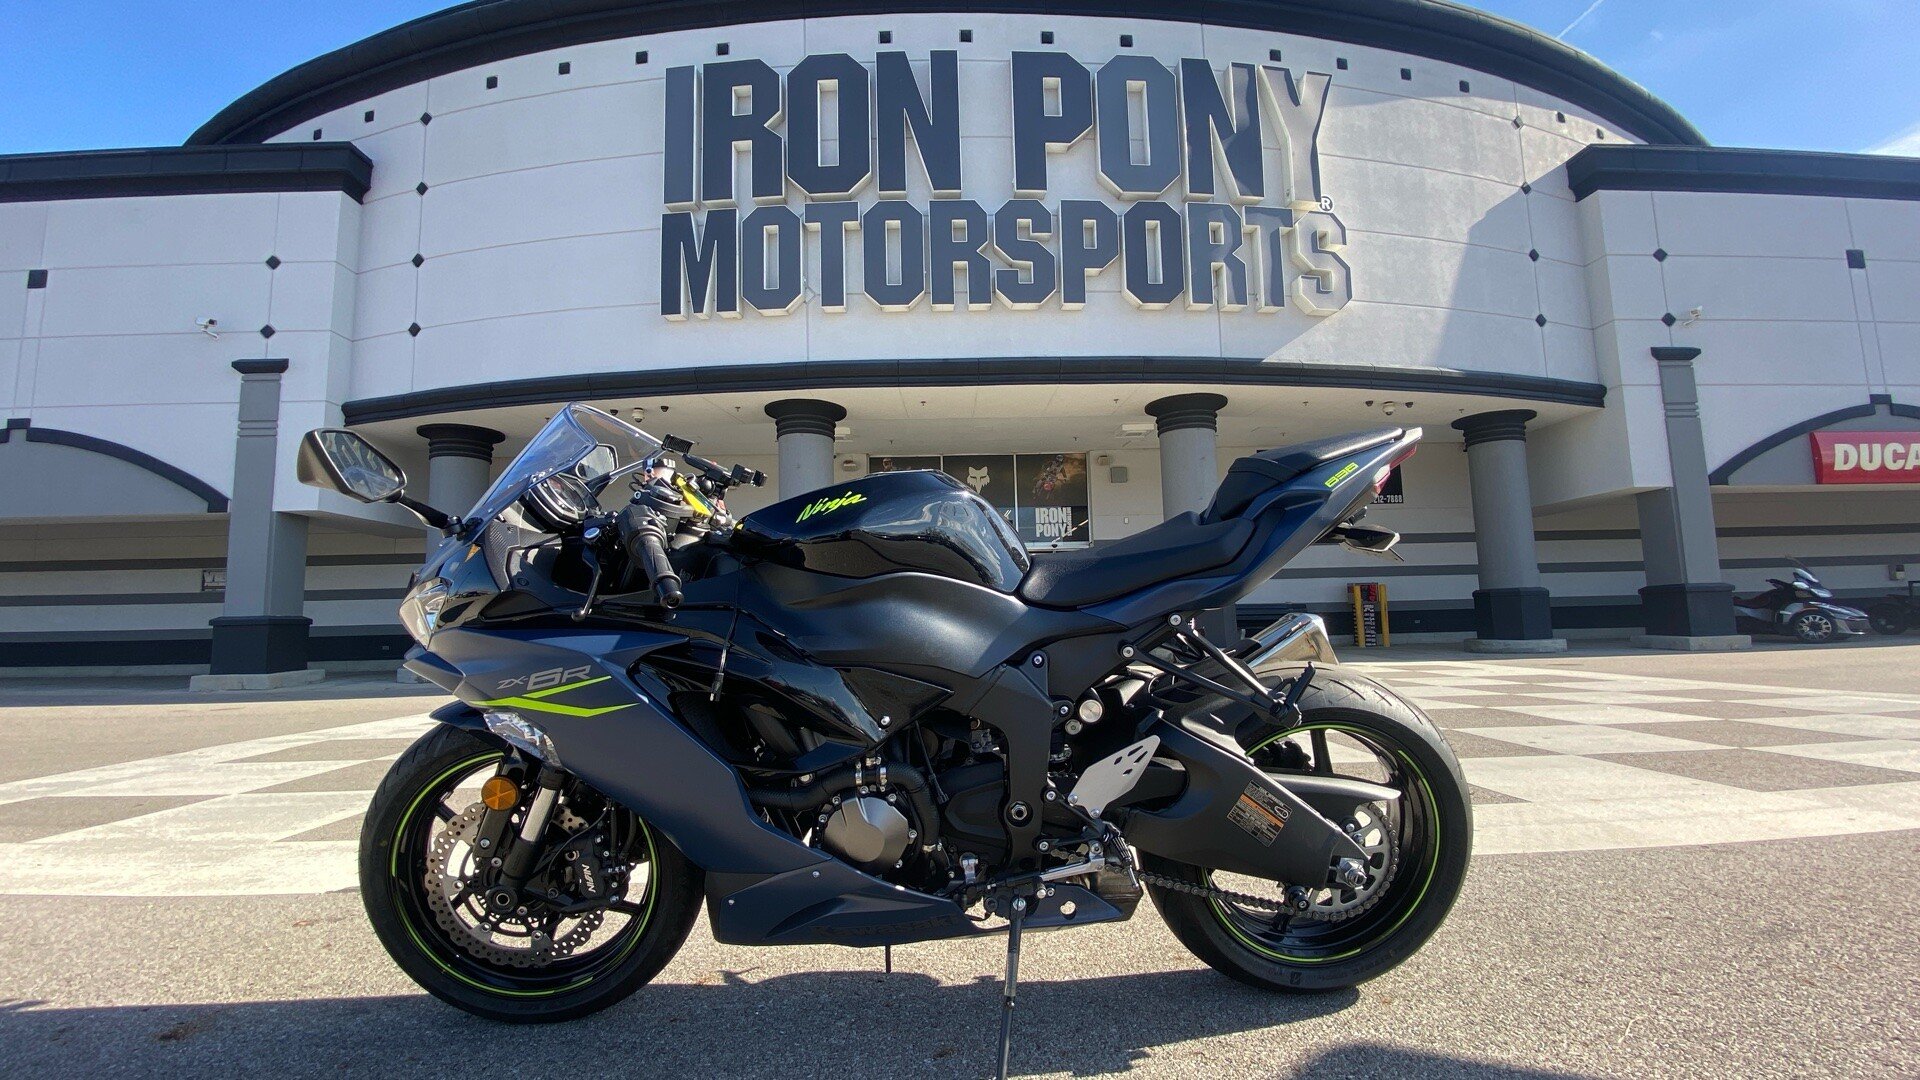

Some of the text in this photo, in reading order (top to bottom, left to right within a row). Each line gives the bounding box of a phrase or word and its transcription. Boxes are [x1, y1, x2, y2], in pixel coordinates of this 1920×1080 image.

[664, 50, 1332, 211] IRON PONY
[659, 199, 1353, 321] MOTORSPORTS
[795, 491, 868, 524] Ninja
[1035, 507, 1067, 524] IRON
[1035, 523, 1067, 538] PONY
[497, 664, 592, 691] ZX-6R
